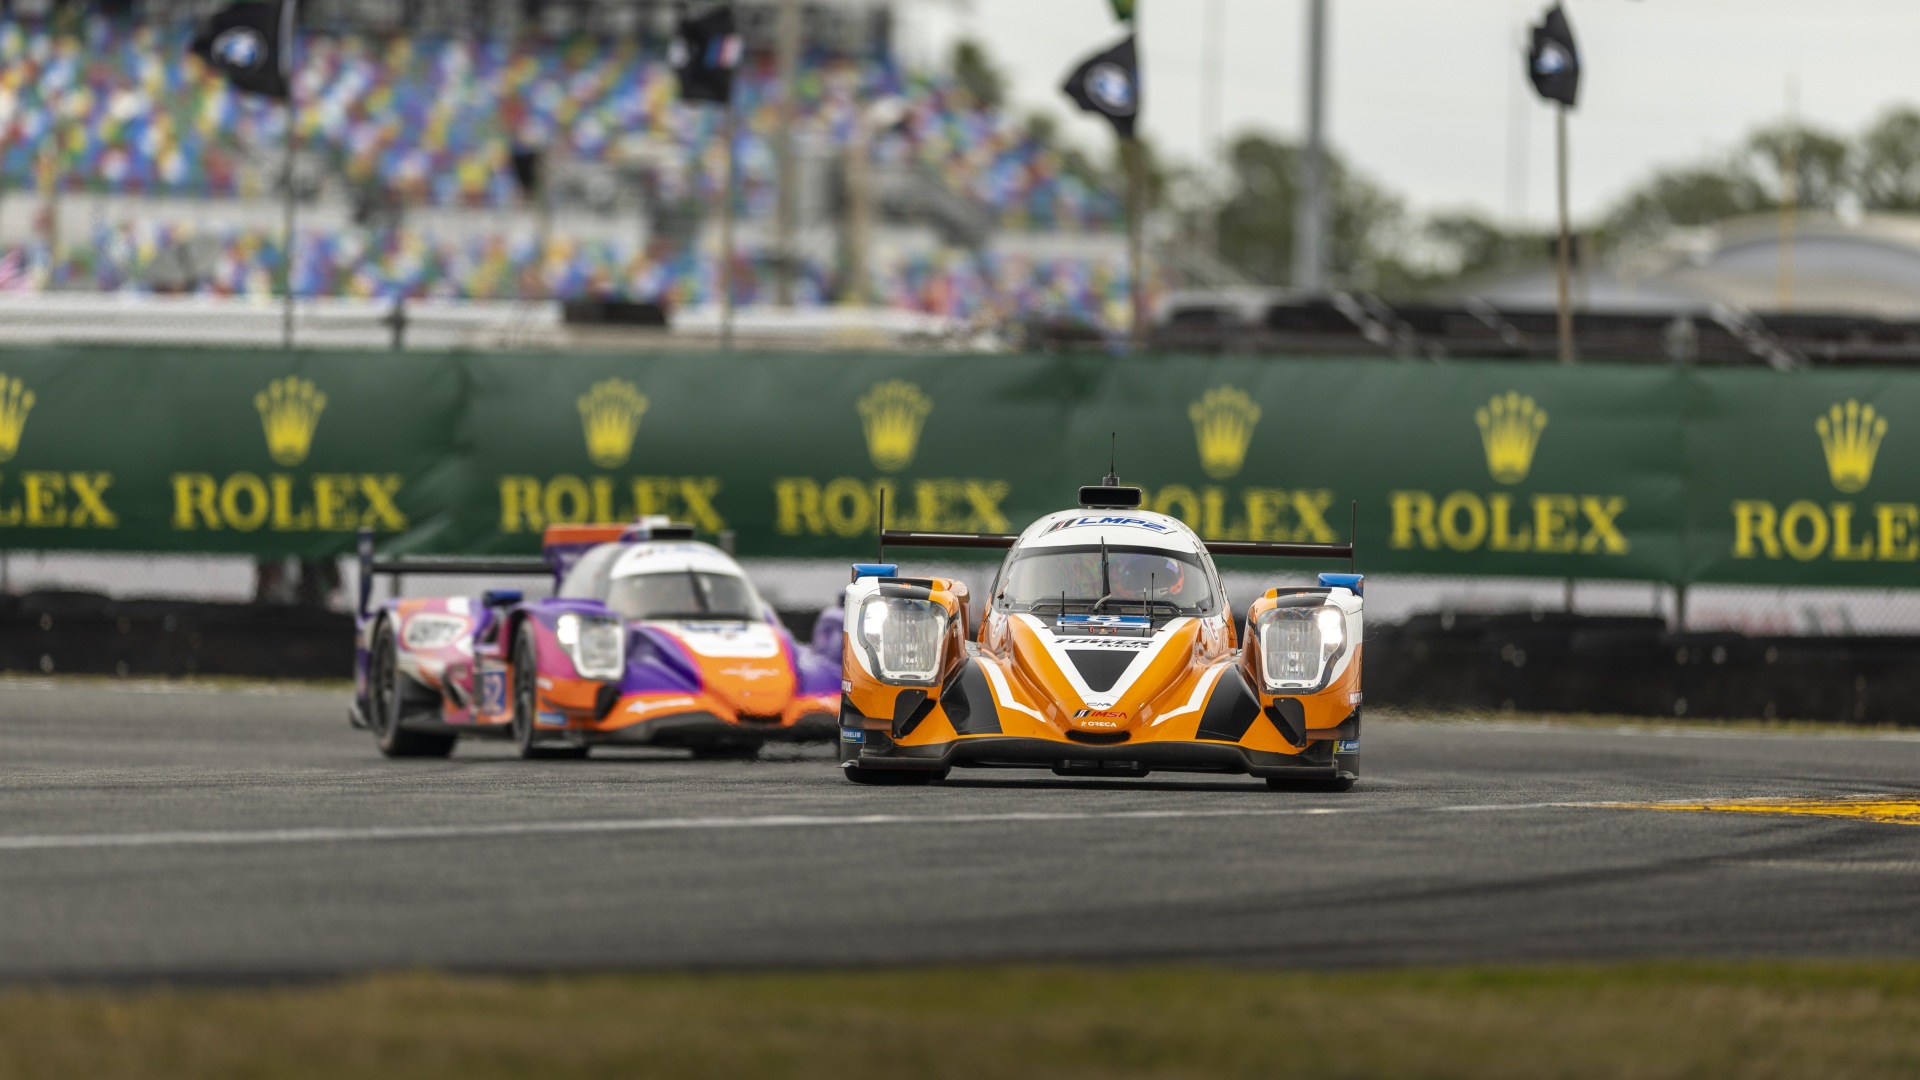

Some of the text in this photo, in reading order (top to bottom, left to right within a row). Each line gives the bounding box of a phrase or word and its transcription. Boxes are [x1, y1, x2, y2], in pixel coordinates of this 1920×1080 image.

[172, 472, 405, 532] ROLEX
[499, 475, 722, 533] ROLEX
[775, 477, 1011, 536] ROLEX
[1077, 517, 1167, 531] LMP2
[1118, 483, 1337, 543] OLEX
[1389, 491, 1628, 552] ROLEX
[1054, 638, 1155, 646] TOWER
[1090, 711, 1128, 719] IMSA
